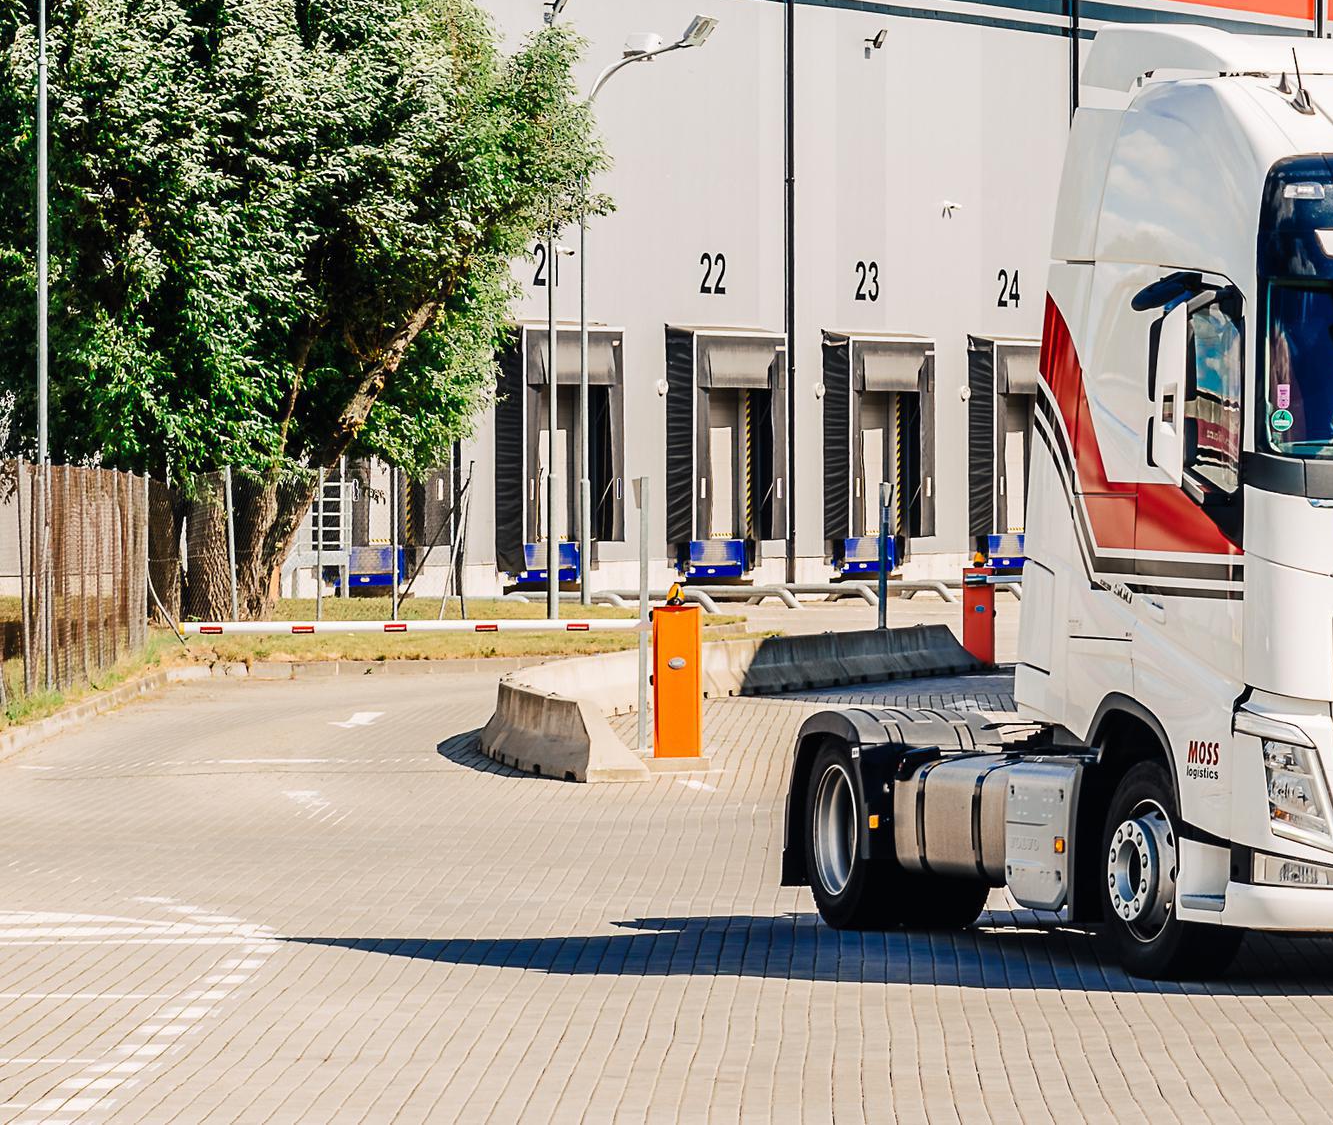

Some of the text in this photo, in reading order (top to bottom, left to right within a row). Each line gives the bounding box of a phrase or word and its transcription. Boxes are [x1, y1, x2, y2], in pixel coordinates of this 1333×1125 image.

[700, 252, 726, 295] 22
[855, 261, 879, 302] 23
[997, 269, 1020, 308] 24
[1187, 740, 1219, 765] MOSS
[1186, 765, 1219, 780] logistics
